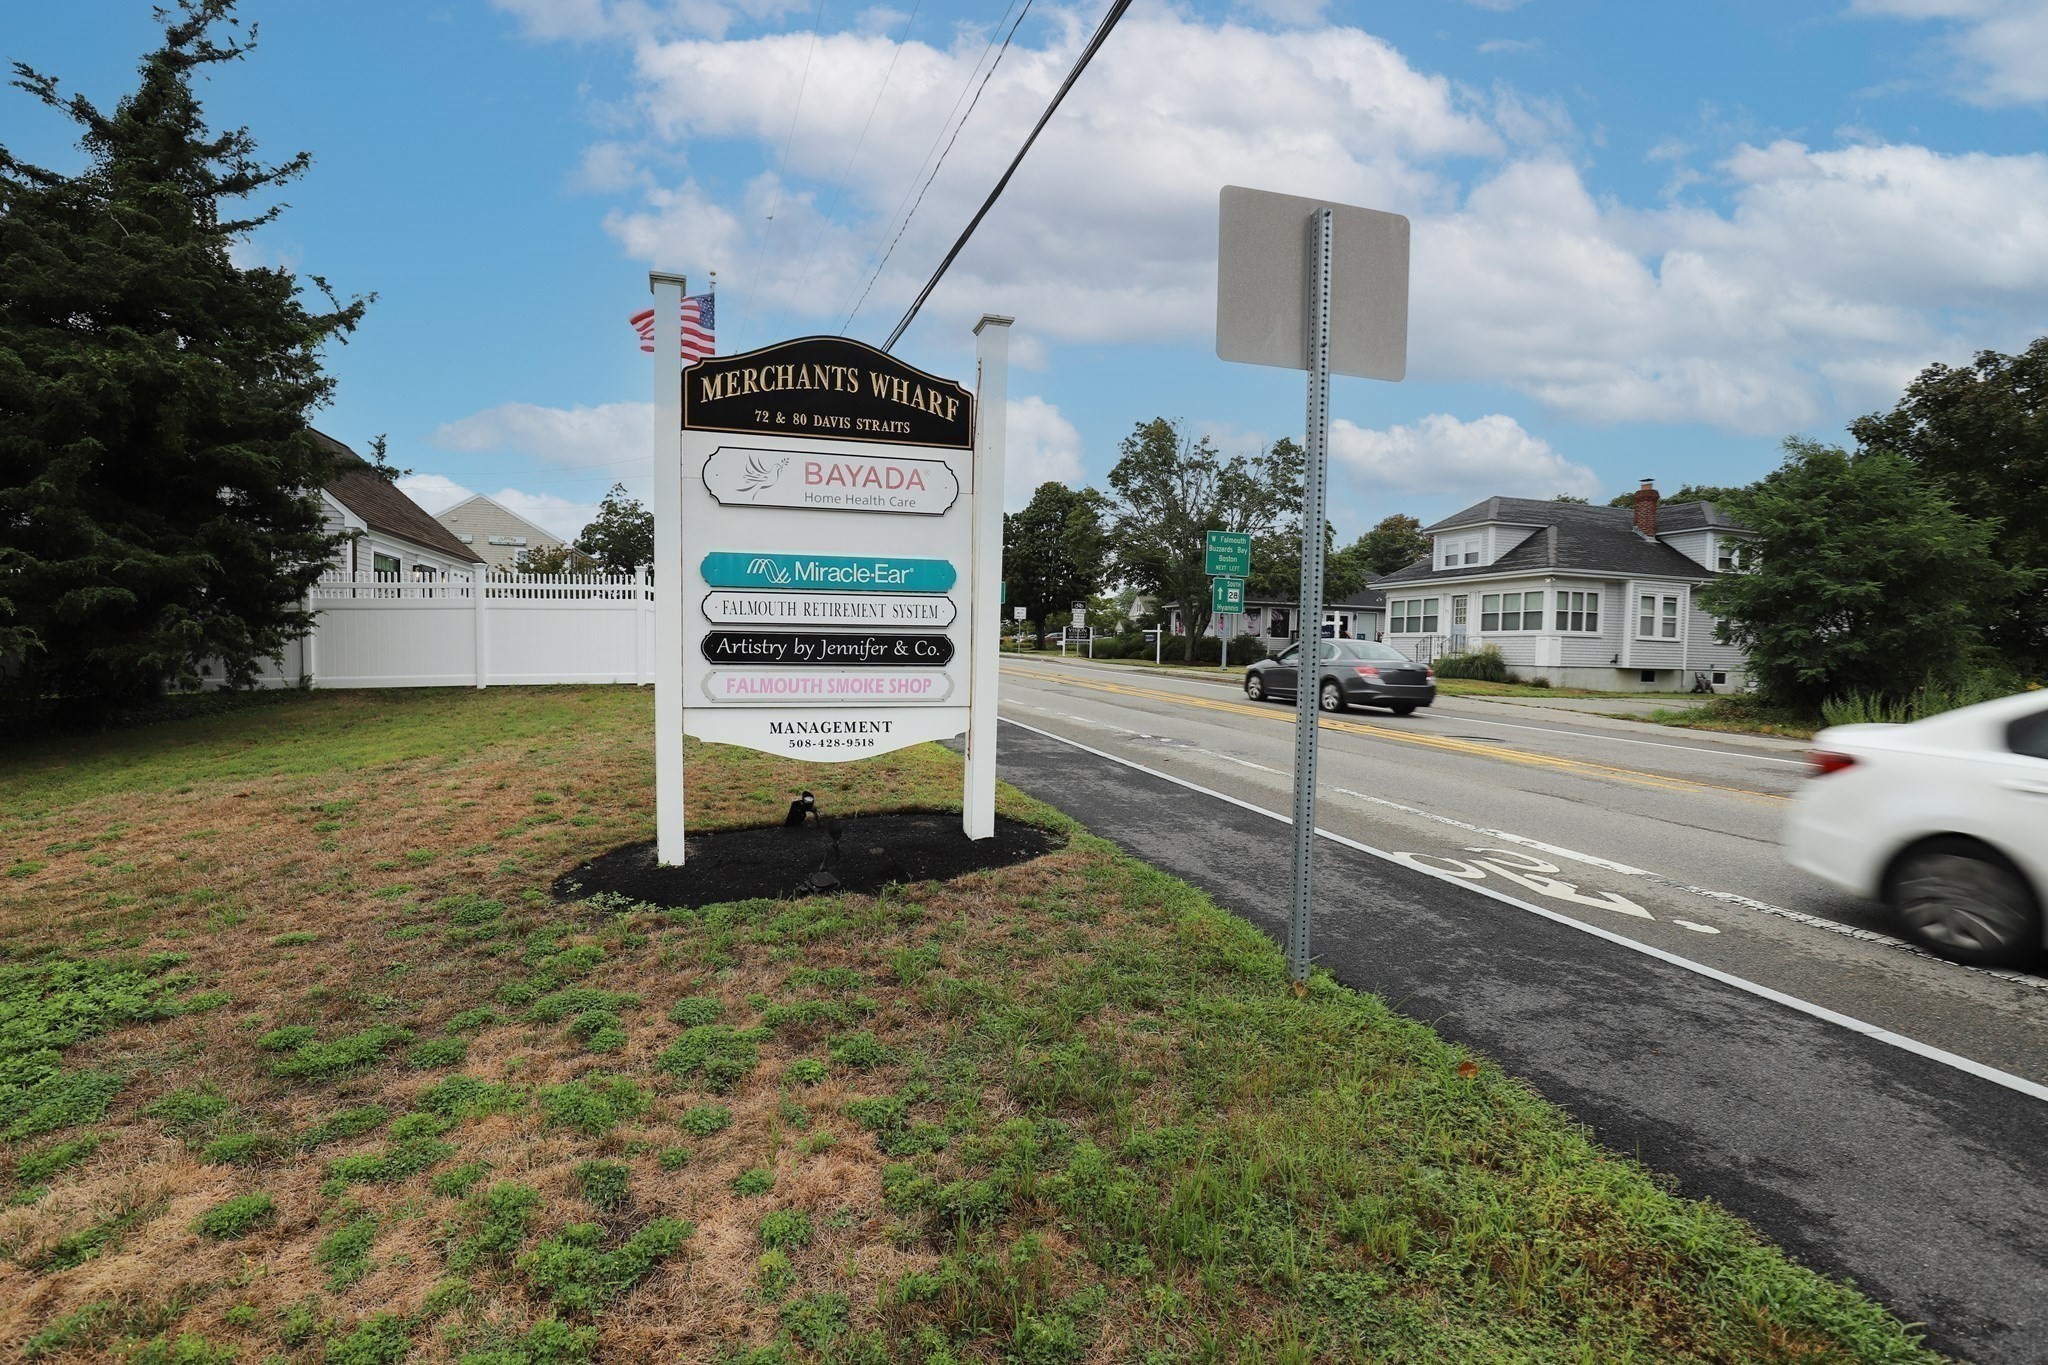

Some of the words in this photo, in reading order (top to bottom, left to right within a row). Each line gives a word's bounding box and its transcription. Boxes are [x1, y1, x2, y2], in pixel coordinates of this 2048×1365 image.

[700, 363, 859, 403] MERCHANTS
[869, 370, 960, 422] WHARF
[754, 409, 769, 424] 72
[775, 413, 786, 424] &
[792, 412, 807, 426] 80
[813, 414, 851, 429] DAVIS
[856, 418, 911, 434] STRAITS
[804, 461, 926, 491] BAYADA
[804, 492, 841, 504] Home
[845, 493, 886, 506] Health
[889, 495, 916, 508] Care
[1220, 536, 1246, 544] Falmouth
[1209, 545, 1233, 553] Buzzards
[1237, 547, 1248, 555] Bay
[1228, 591, 1238, 599] 28
[722, 599, 797, 617] FALMOUTH
[803, 601, 886, 618] RETIREMENT
[892, 603, 939, 619] SYSTEM
[716, 637, 787, 660] Artistry
[794, 637, 815, 659] by
[817, 637, 888, 662] Jennifer
[894, 640, 909, 656] &
[914, 640, 940, 656] Co.
[726, 677, 823, 694] FALMOUTH
[827, 677, 884, 694] SMOKE
[889, 678, 932, 694] SHOP
[769, 720, 893, 735] MANAGEMENT
[788, 738, 875, 748] 508-428-9518
